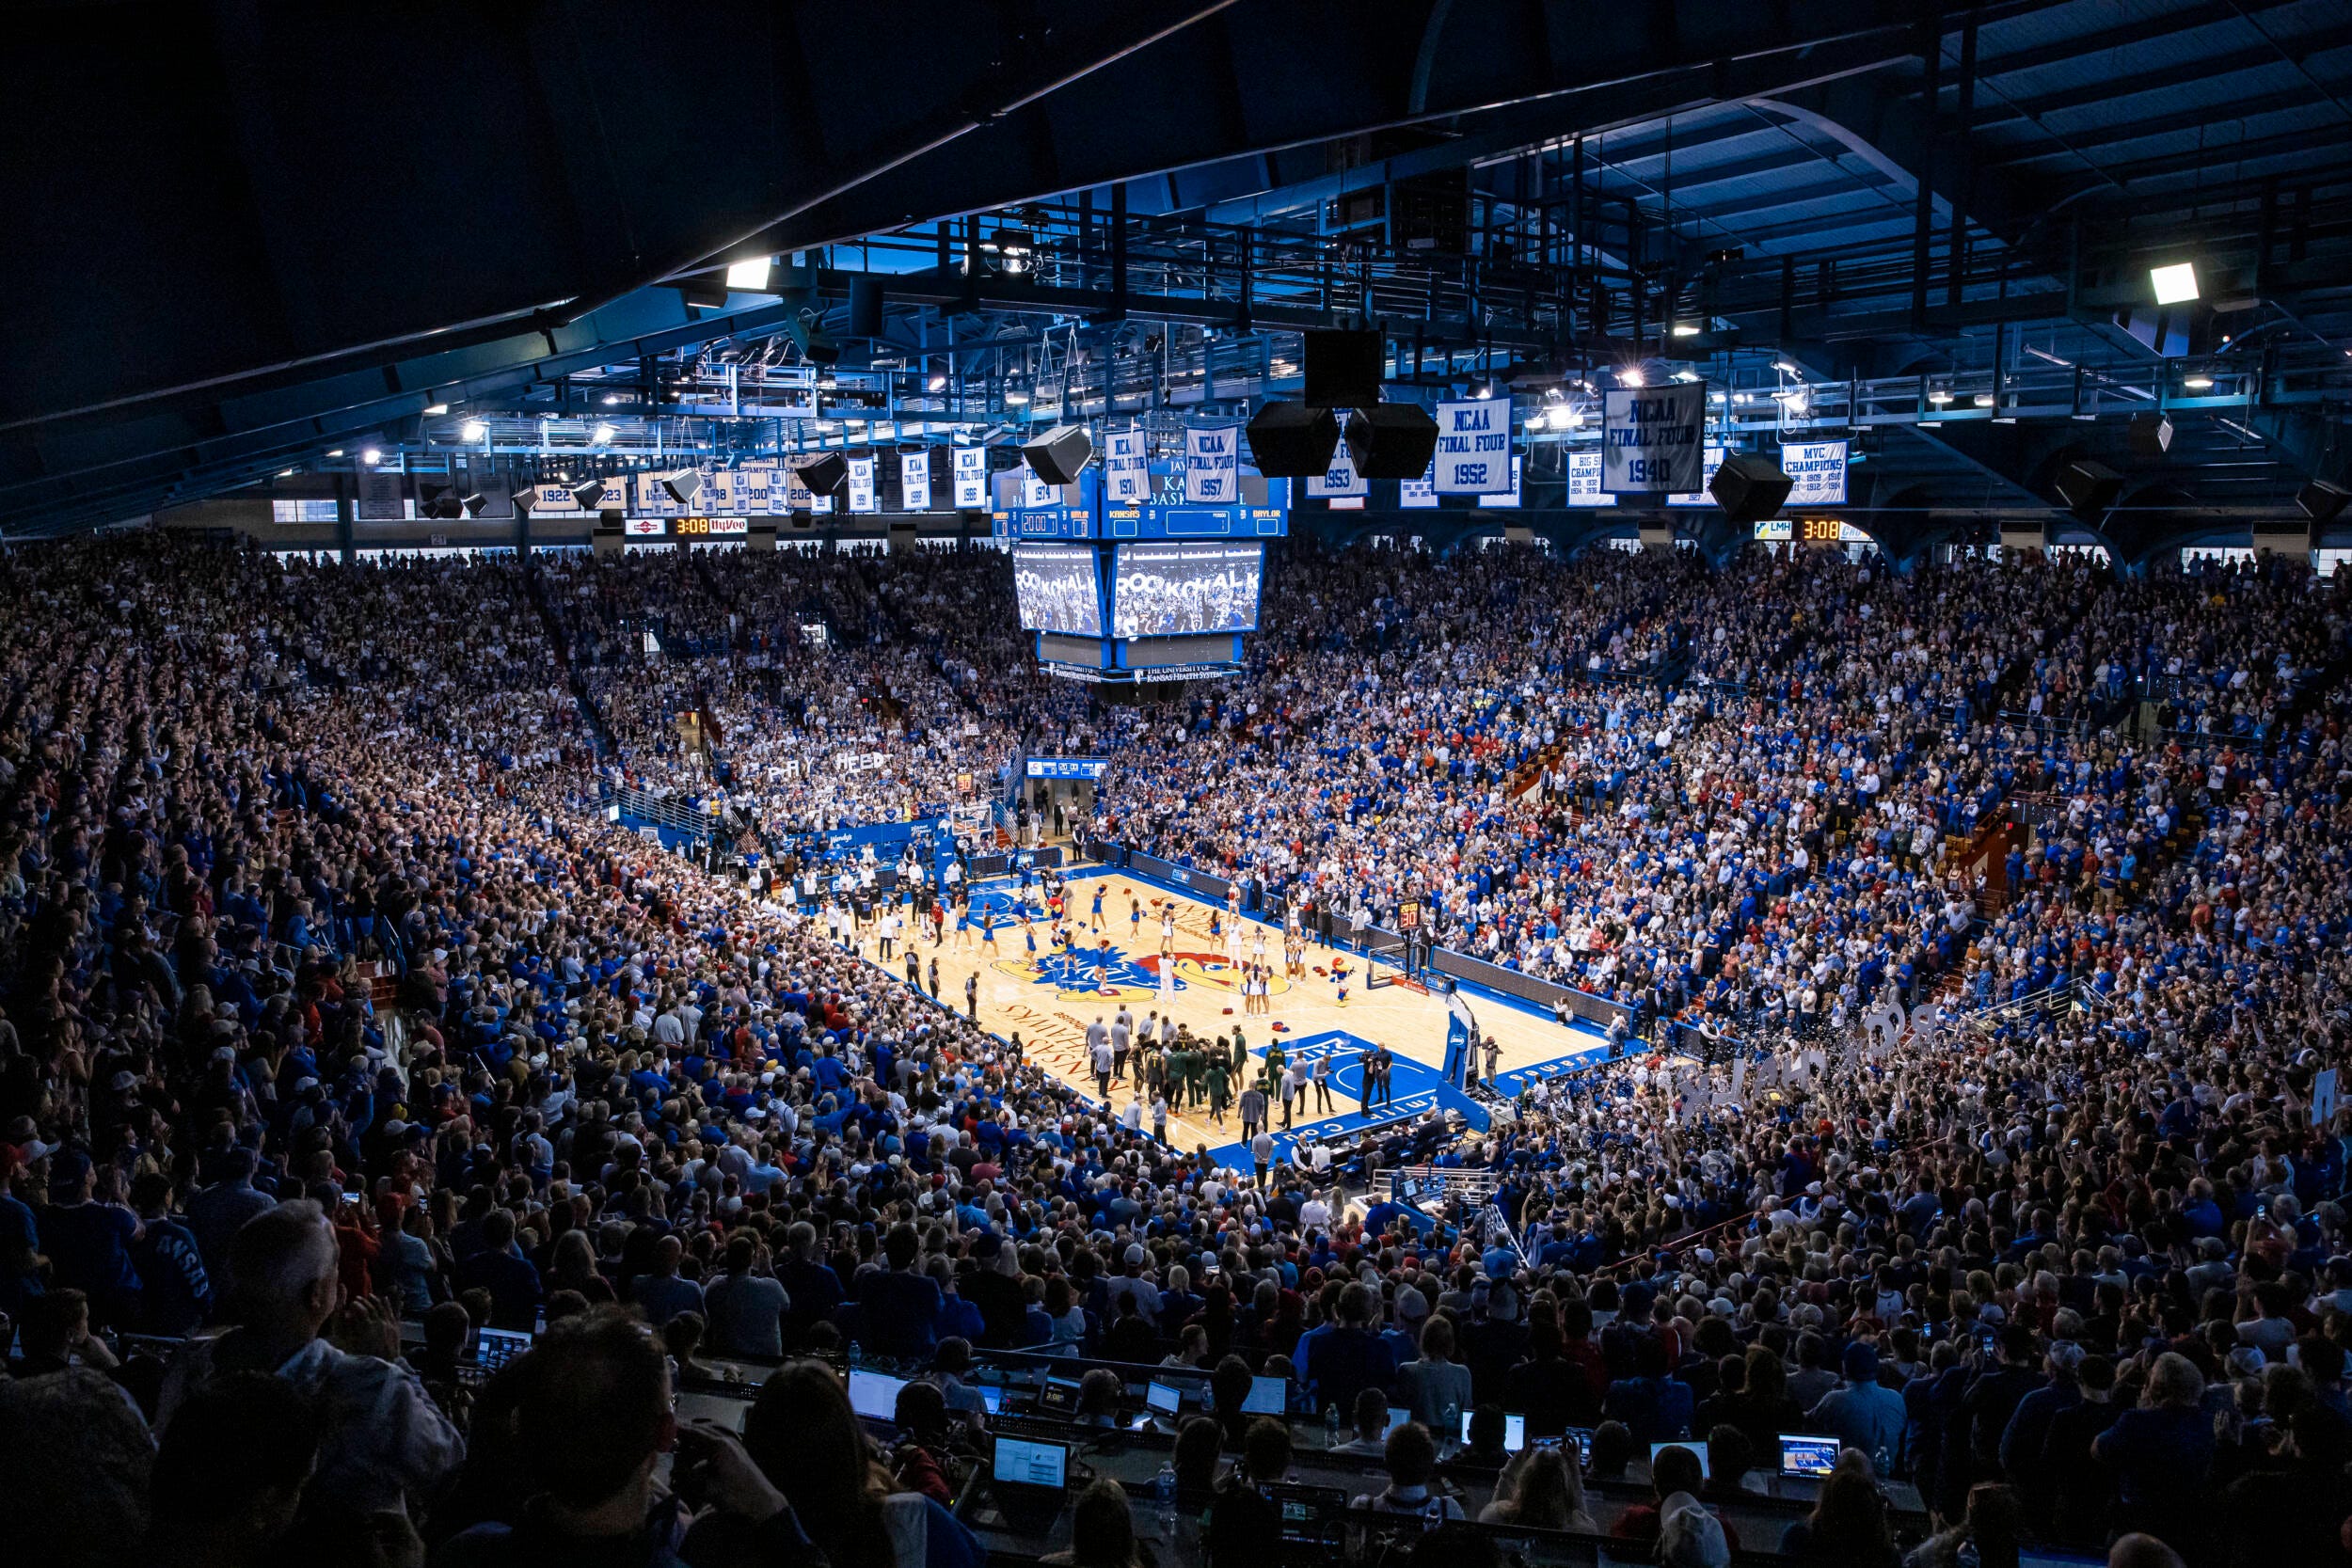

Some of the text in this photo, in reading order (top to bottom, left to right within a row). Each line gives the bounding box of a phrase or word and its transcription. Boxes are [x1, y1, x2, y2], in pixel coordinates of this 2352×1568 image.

[1629, 398, 1676, 423] NCAA
[1454, 409, 1490, 432] NCAA
[1438, 433, 1505, 453] FINAL FOUR
[1610, 424, 1694, 448] FINAL FOUR
[1199, 436, 1225, 452] NCAA
[961, 453, 977, 467] NCAA
[1804, 448, 1825, 459] MVC
[1108, 459, 1125, 471] FINAL
[1188, 455, 1212, 470] FINAL
[1215, 454, 1234, 469] FOUR
[1579, 456, 1602, 467] BIG SI
[1786, 459, 1843, 473] CHAMPIONS
[956, 470, 970, 481] FINAL
[1454, 463, 1487, 484] 1952
[1571, 467, 1601, 478] CHAMPI
[1629, 458, 1671, 483] 1940
[1325, 469, 1349, 488] 1953
[963, 487, 977, 501] 1986
[1035, 485, 1051, 500] 1974
[1200, 479, 1222, 496] 1957
[1806, 483, 1821, 491] 1912
[543, 490, 571, 501] 1922
[790, 489, 811, 500] 202
[1109, 510, 1140, 518] KANSAS
[676, 519, 708, 533] 3:08
[1771, 522, 1791, 531] LMH
[1804, 521, 1838, 539] 3:08
[1162, 665, 1200, 673] UNIVERSITY
[1147, 671, 1223, 683] KANSAS HEALTH SYSTEM
[959, 781, 971, 790] 30
[1401, 902, 1418, 912] 20:00
[1401, 912, 1415, 927] 30
